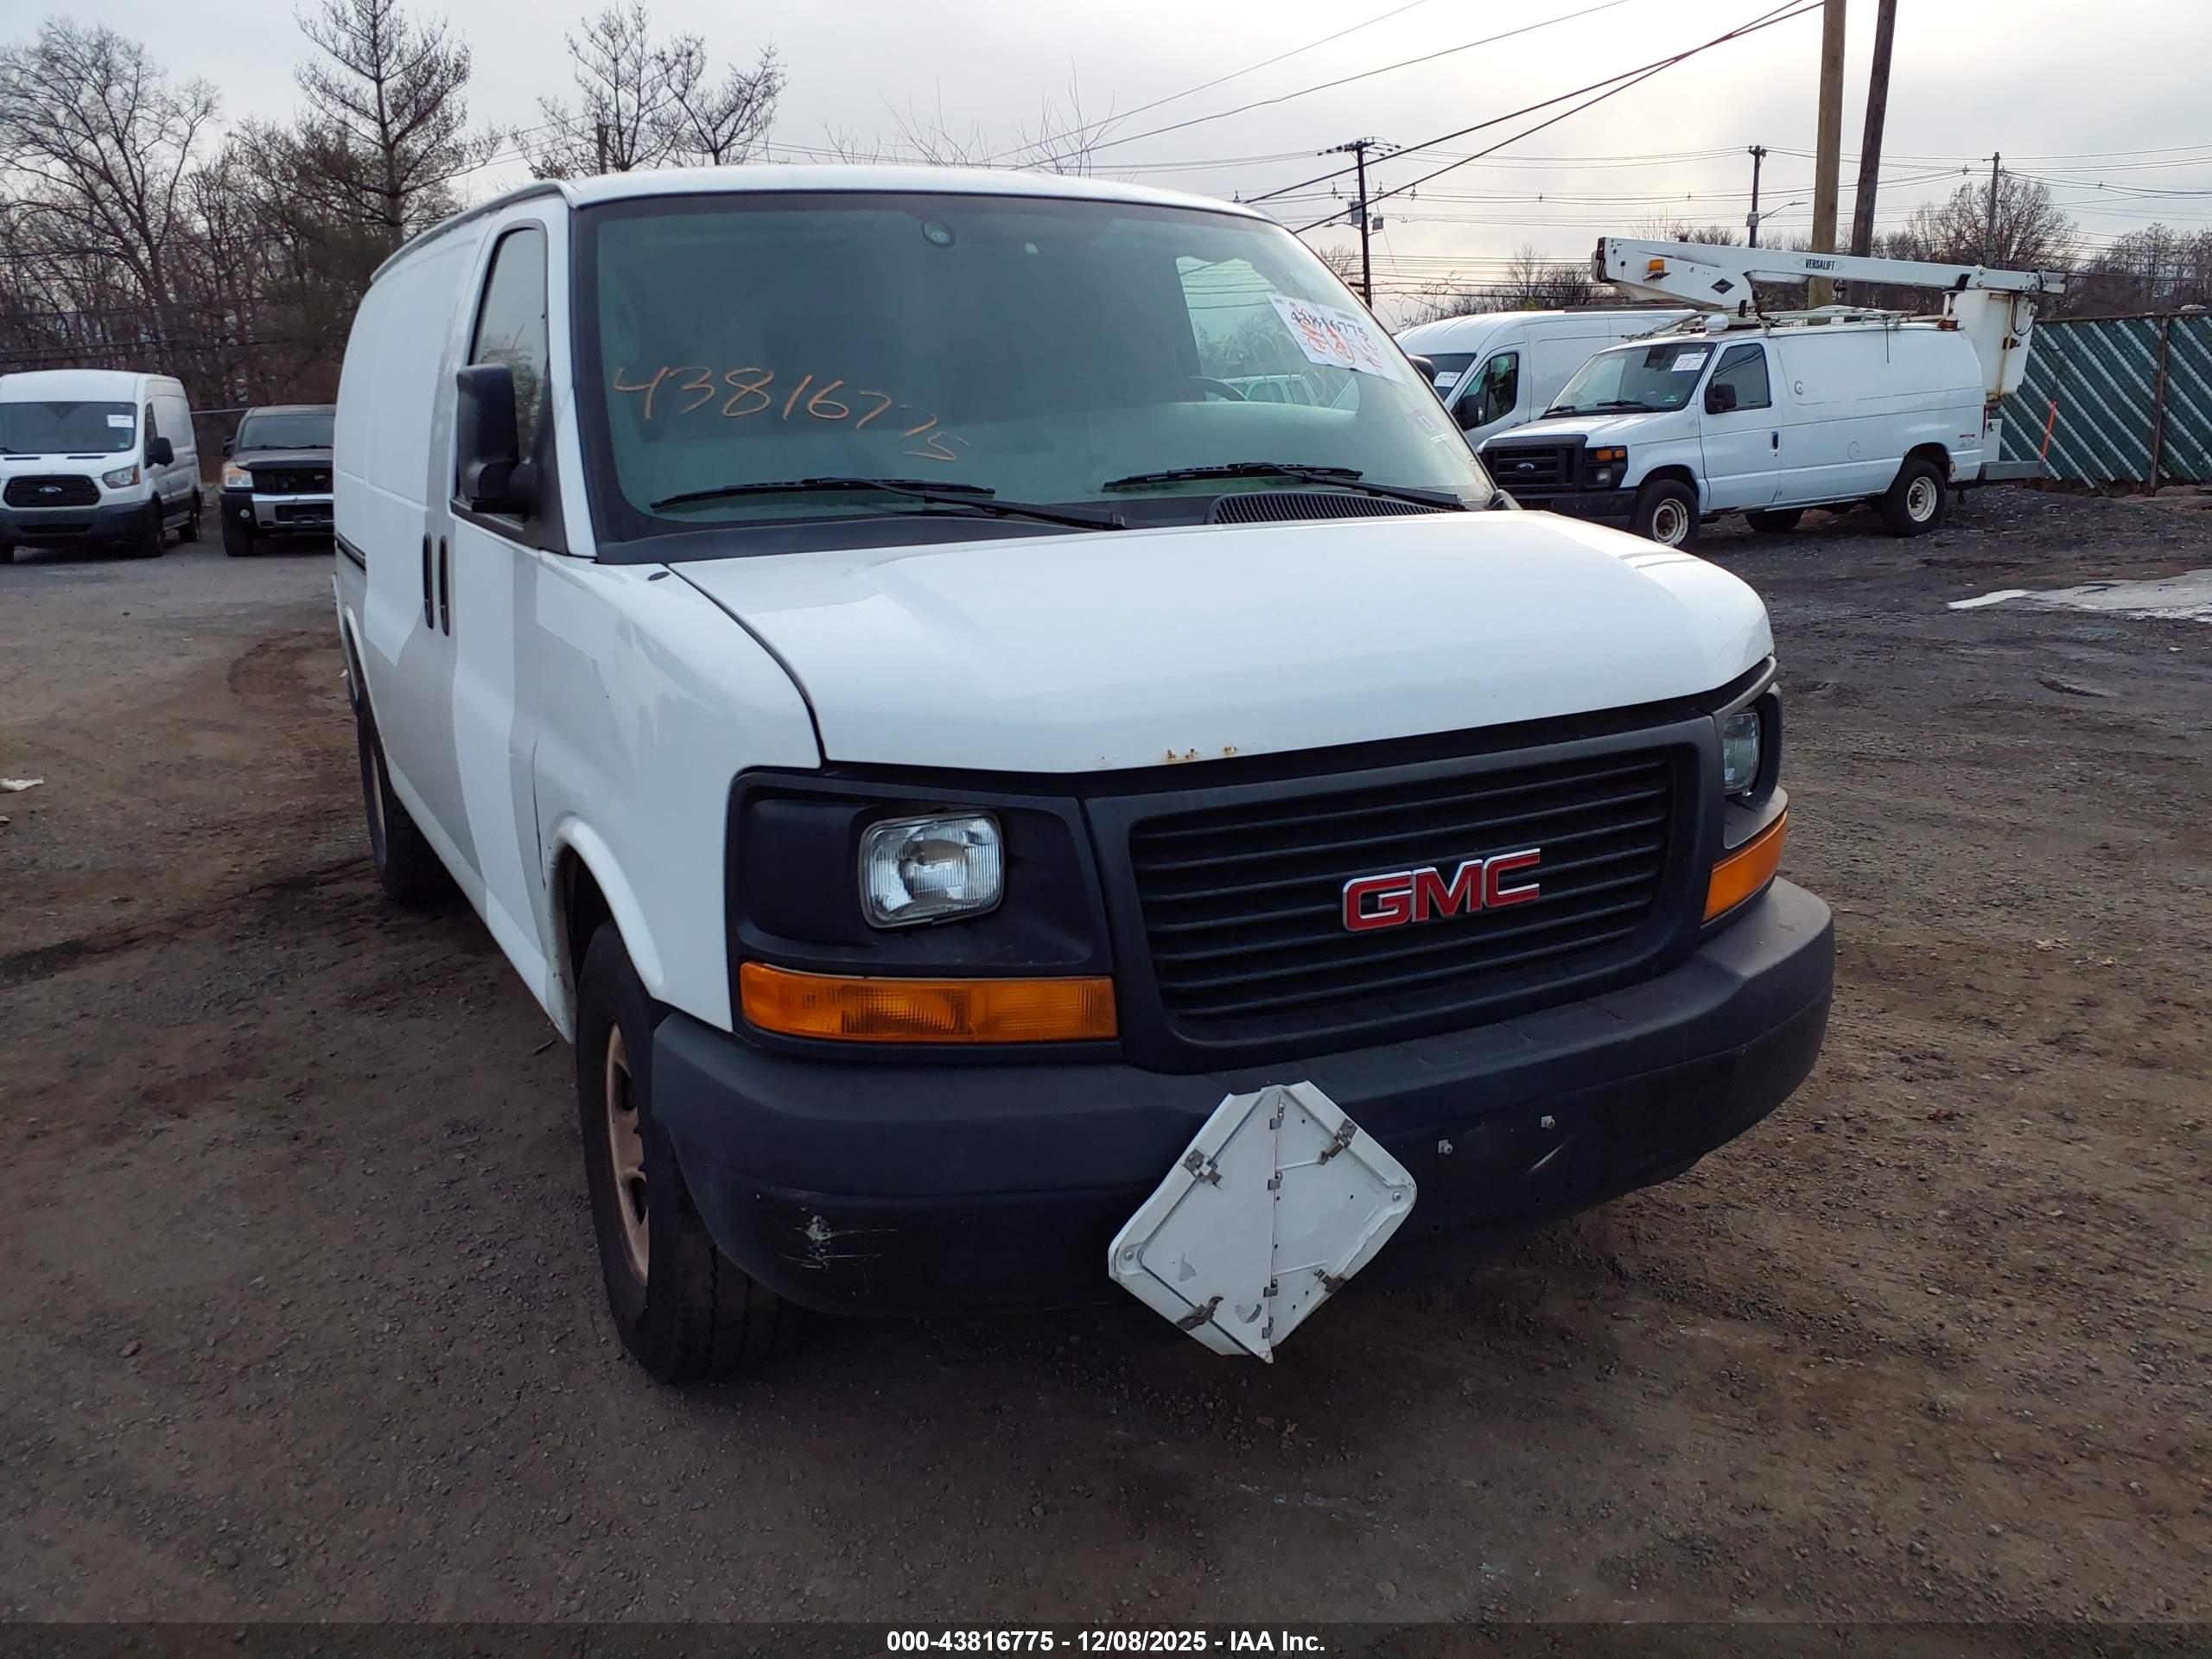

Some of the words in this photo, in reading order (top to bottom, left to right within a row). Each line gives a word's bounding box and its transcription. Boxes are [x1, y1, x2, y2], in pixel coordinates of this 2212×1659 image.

[1805, 258, 1836, 270] VERSALIFT
[613, 365, 969, 461] 43816775
[1343, 848, 1541, 932] GMC
